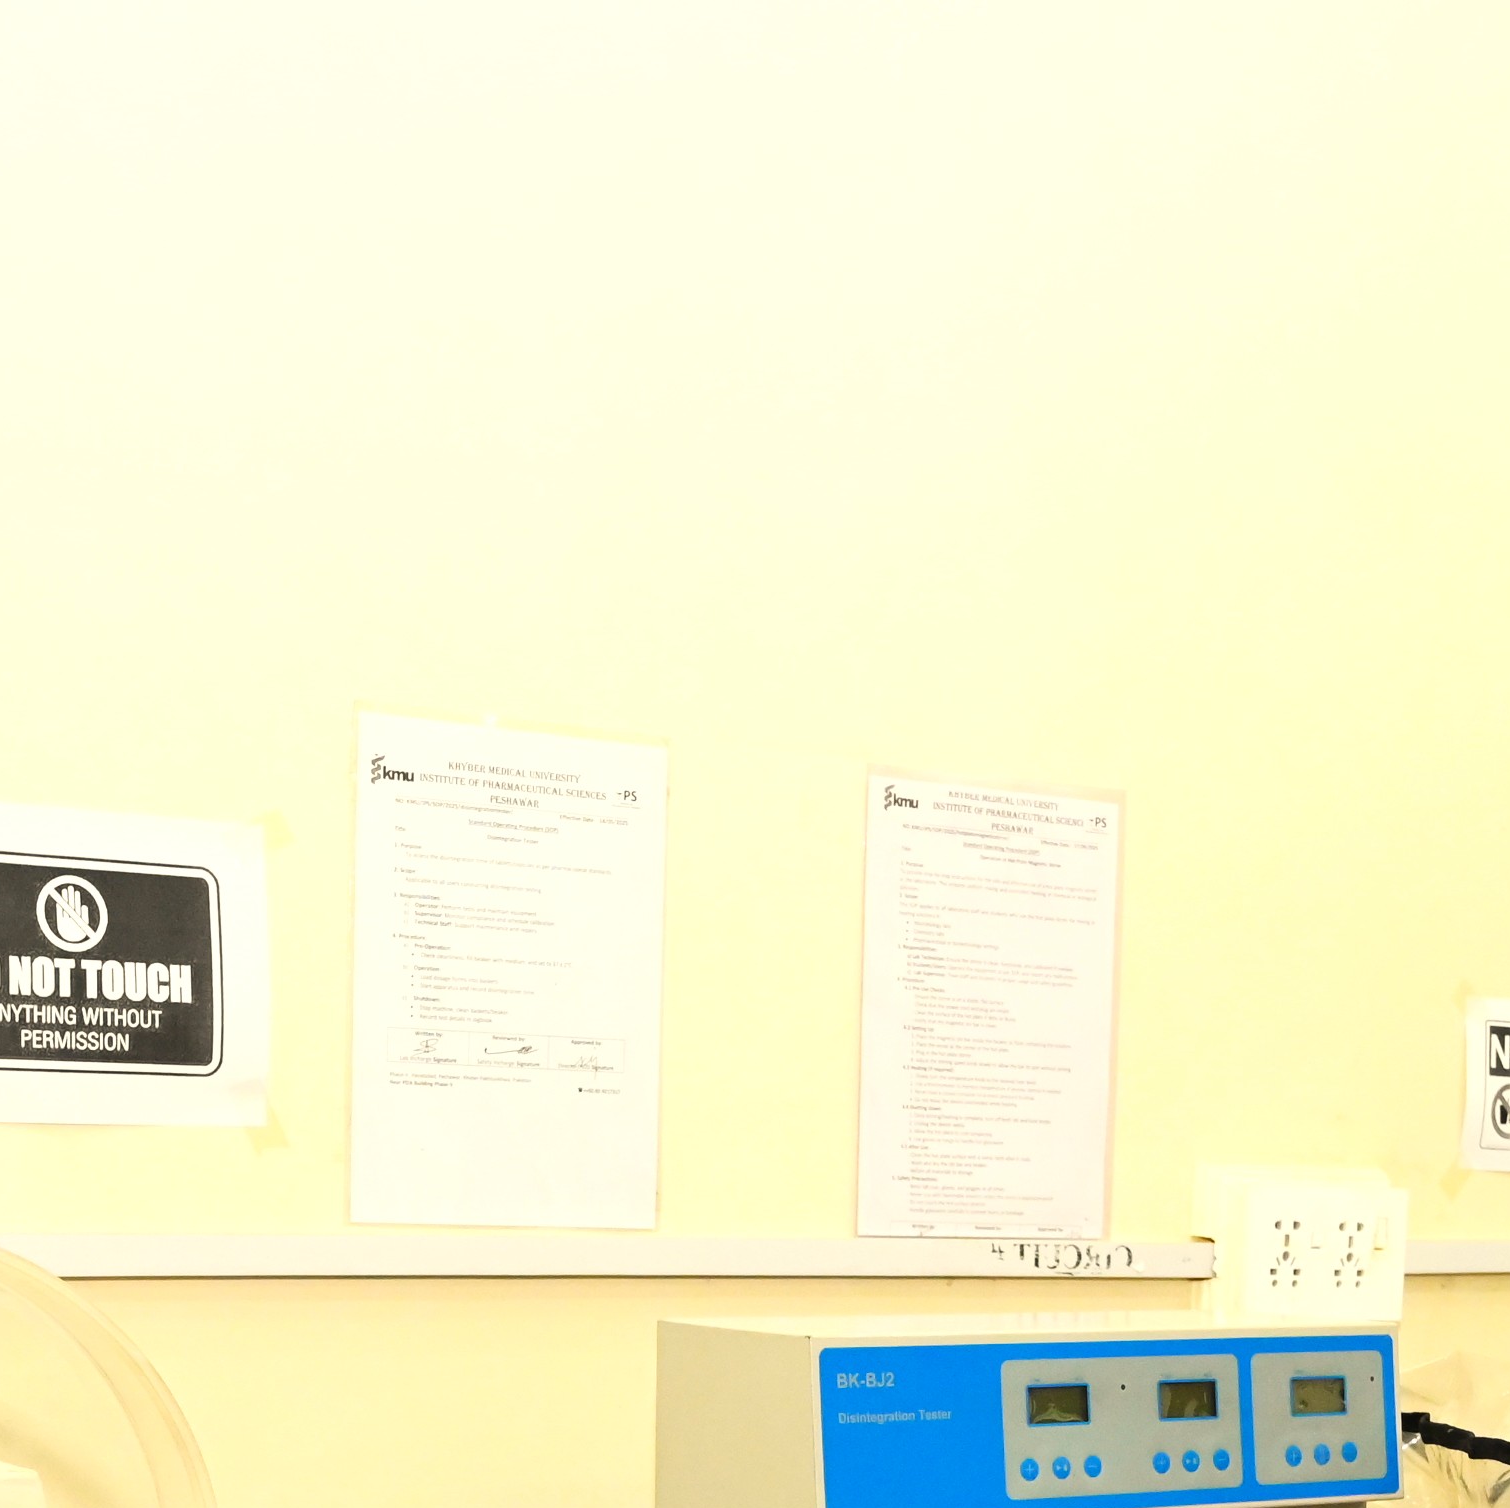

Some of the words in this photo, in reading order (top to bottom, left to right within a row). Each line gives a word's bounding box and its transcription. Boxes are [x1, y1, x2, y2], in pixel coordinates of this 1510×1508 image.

[382, 765, 415, 781] kmu
[448, 761, 486, 773] KHYBER
[488, 765, 525, 777] MEDICAL
[529, 770, 581, 783] UNIVERSITY
[419, 773, 466, 785] INSTITUTE
[468, 778, 479, 786] OF
[482, 779, 564, 795] PHARMACEUTICAL
[565, 788, 607, 800] SCIENCES
[490, 794, 540, 808] PESHAWAR
[893, 793, 919, 808] kmu
[9, 955, 76, 997] NOT
[81, 958, 192, 1003] TOUCH
[82, 1007, 162, 1028] WITHOUT
[21, 1030, 129, 1052] PERMISSION
[837, 1372, 895, 1389] BK-BJ2
[838, 1410, 914, 1425] Disintegration
[918, 1408, 951, 1421] Tester
